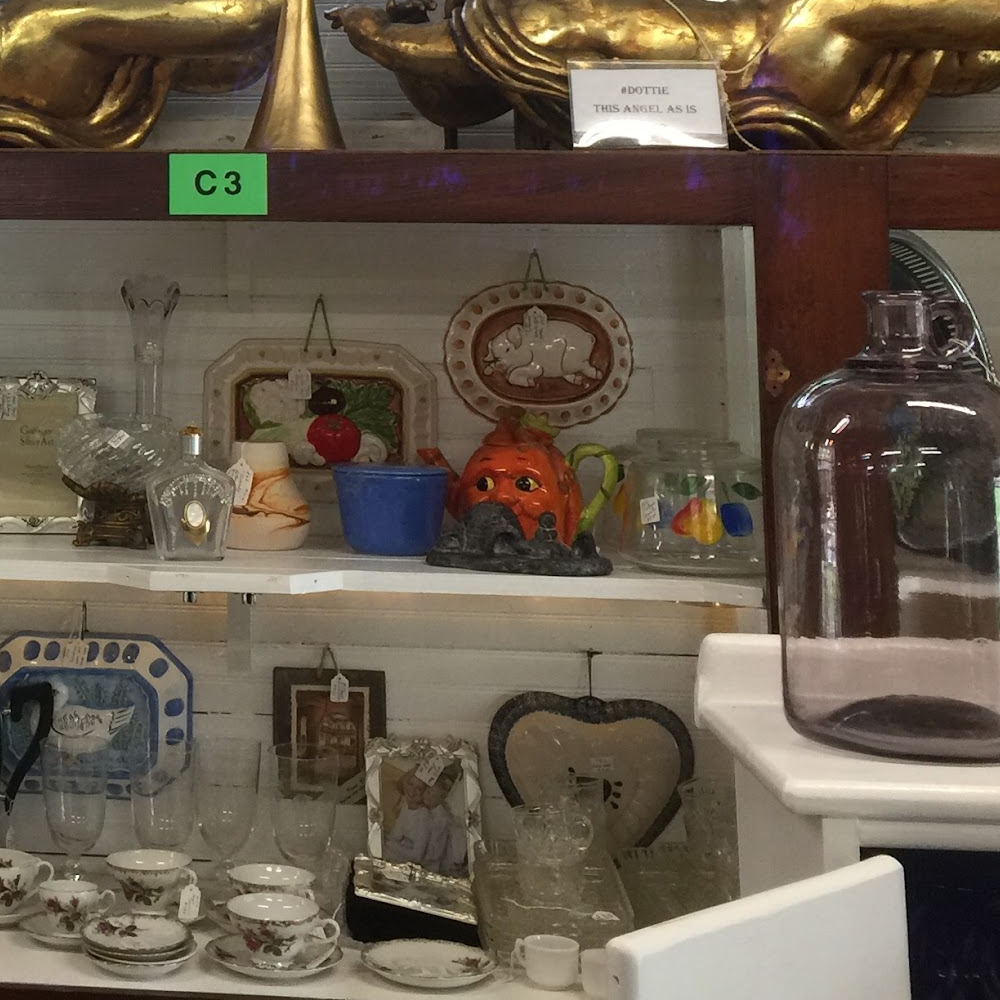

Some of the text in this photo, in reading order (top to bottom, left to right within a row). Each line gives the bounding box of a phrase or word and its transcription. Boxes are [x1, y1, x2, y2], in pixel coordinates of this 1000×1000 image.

[621, 86, 669, 95] #DOTTIE
[593, 104, 697, 114] THIS ANGEL AS IS
